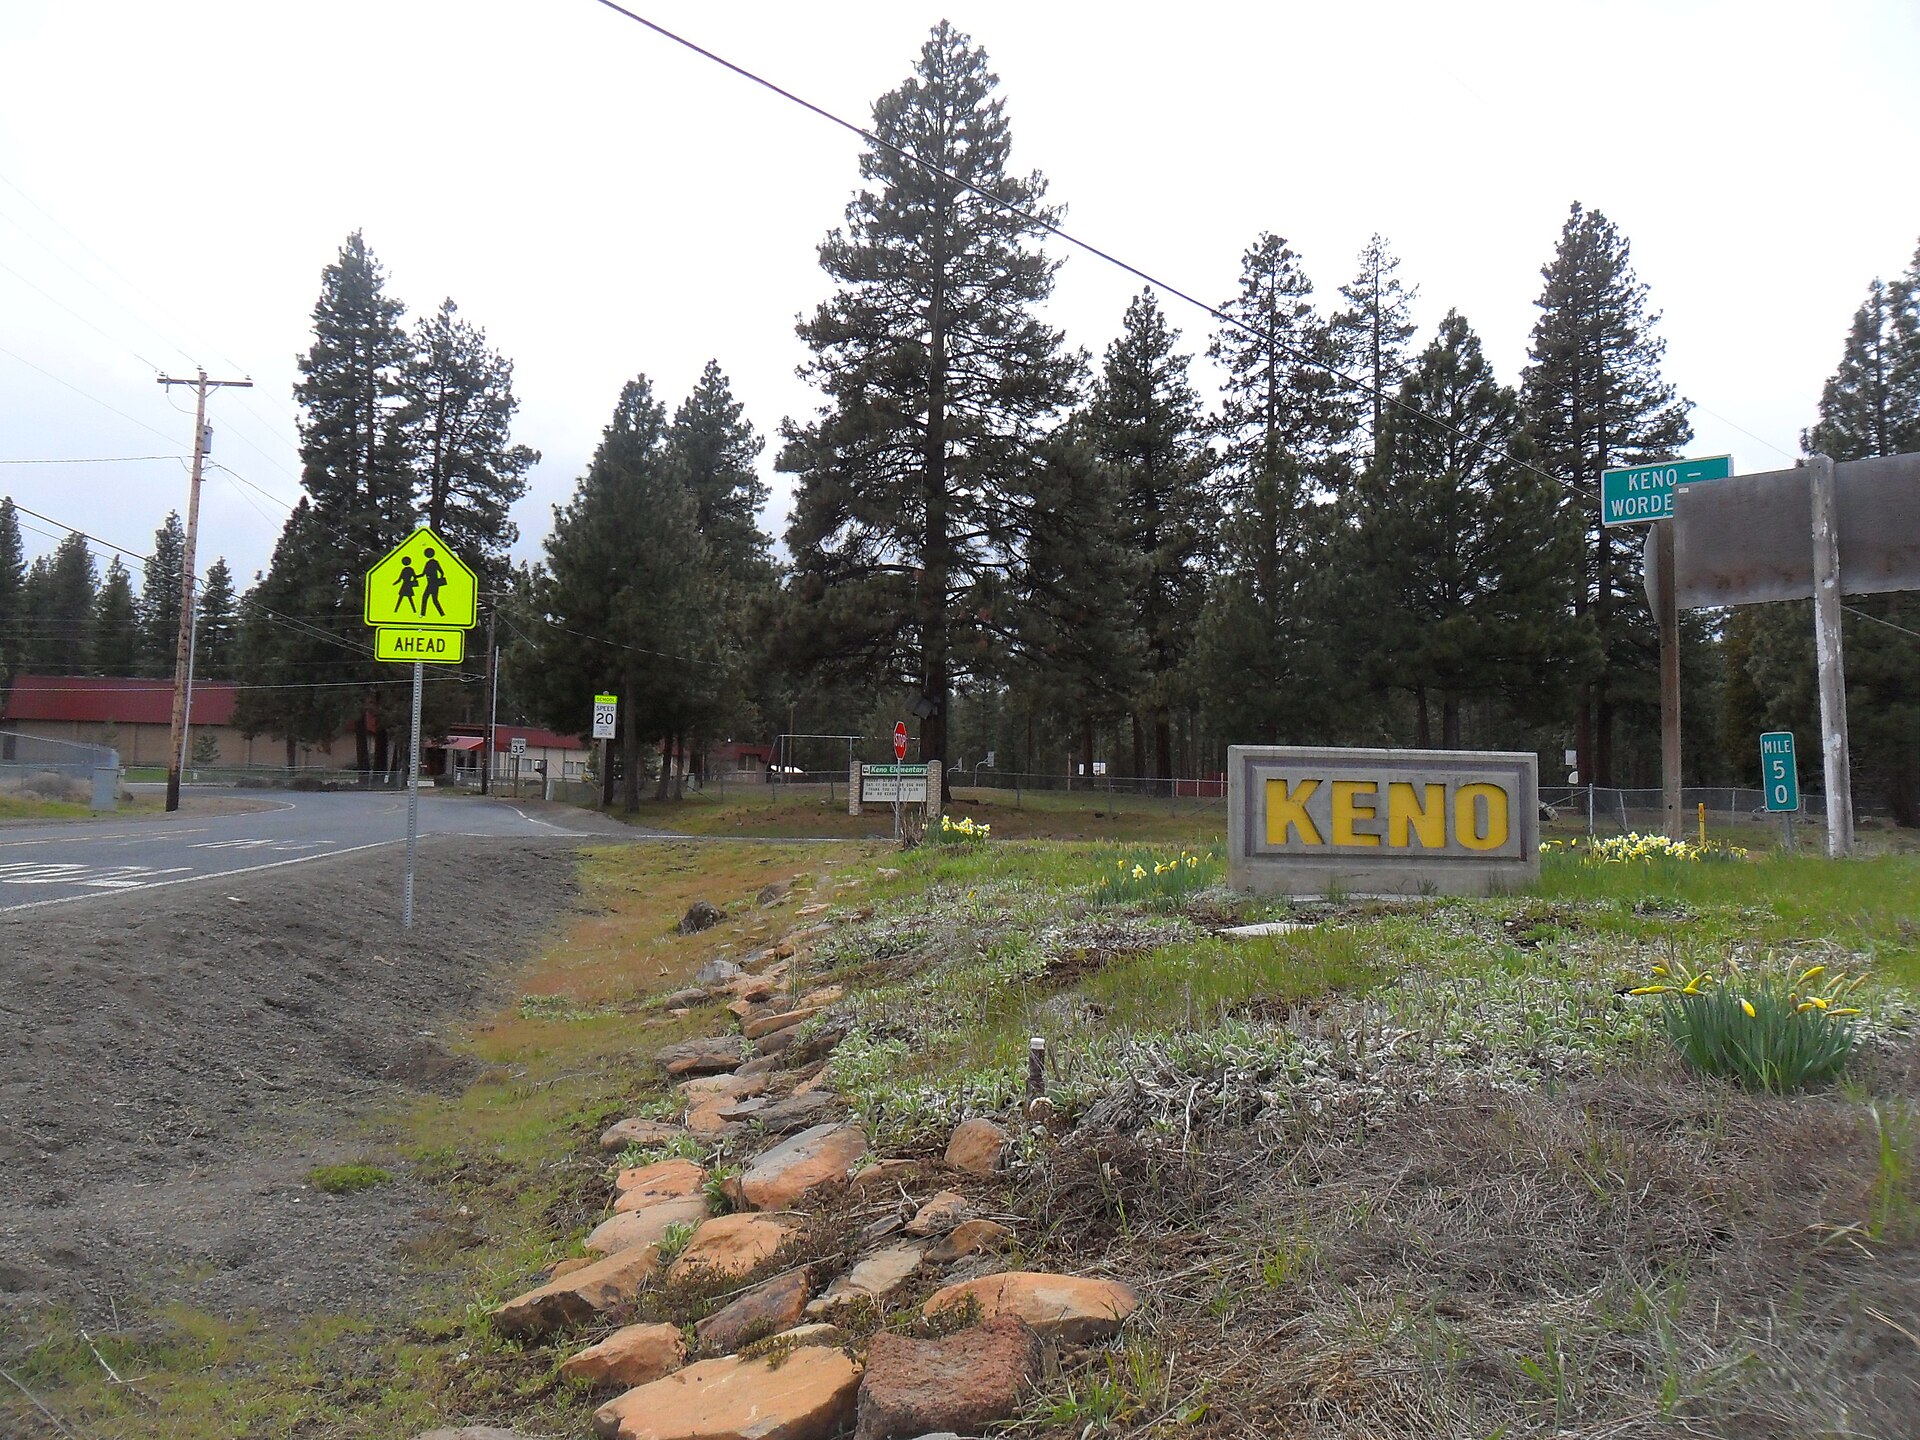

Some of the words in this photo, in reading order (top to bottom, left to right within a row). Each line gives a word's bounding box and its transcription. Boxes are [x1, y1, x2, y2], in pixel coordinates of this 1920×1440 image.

[1628, 468, 1678, 491] KENO
[394, 637, 446, 653] AHEAD
[596, 713, 614, 725] 20
[895, 733, 906, 748] STOP
[1764, 740, 1791, 754] MILE
[512, 745, 525, 753] 35
[1266, 778, 1509, 850] KENO
